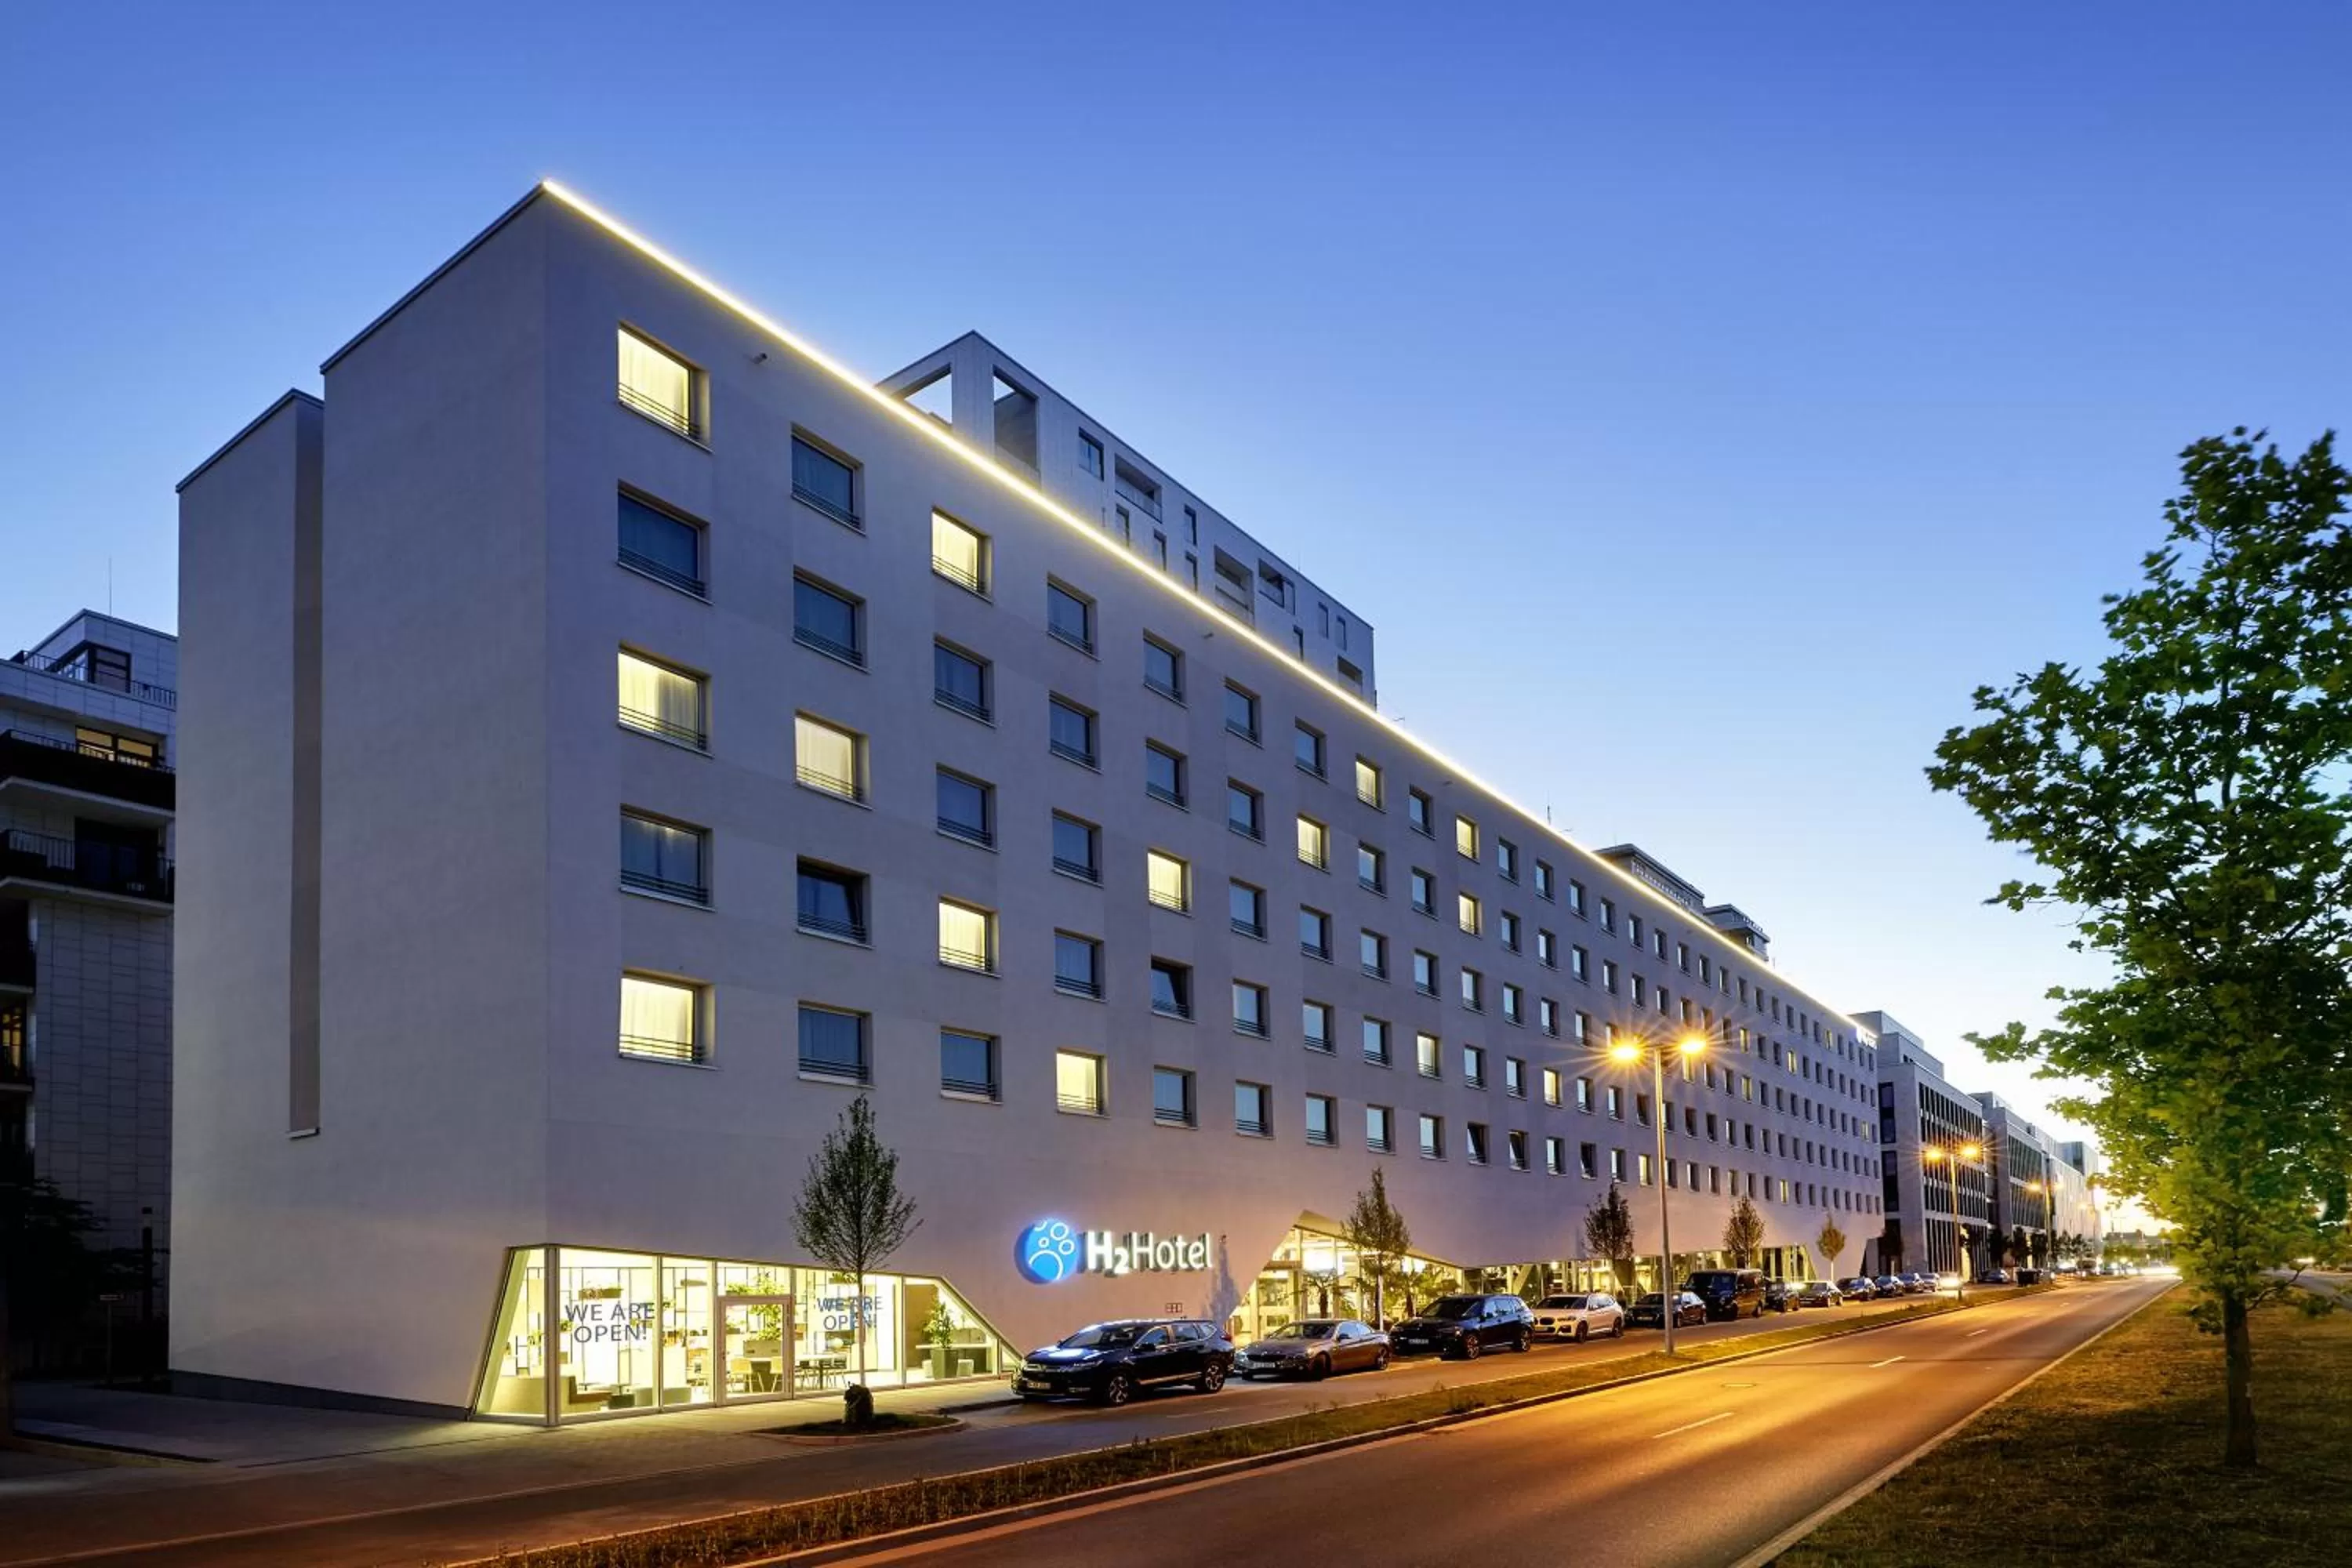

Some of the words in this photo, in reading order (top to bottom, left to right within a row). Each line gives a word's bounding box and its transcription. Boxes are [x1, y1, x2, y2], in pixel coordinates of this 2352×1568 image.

[564, 1304, 603, 1322] WE
[611, 1301, 655, 1321] ARE
[817, 1298, 845, 1312] WE
[849, 1295, 883, 1312] ARE
[574, 1320, 648, 1343] OPEN!
